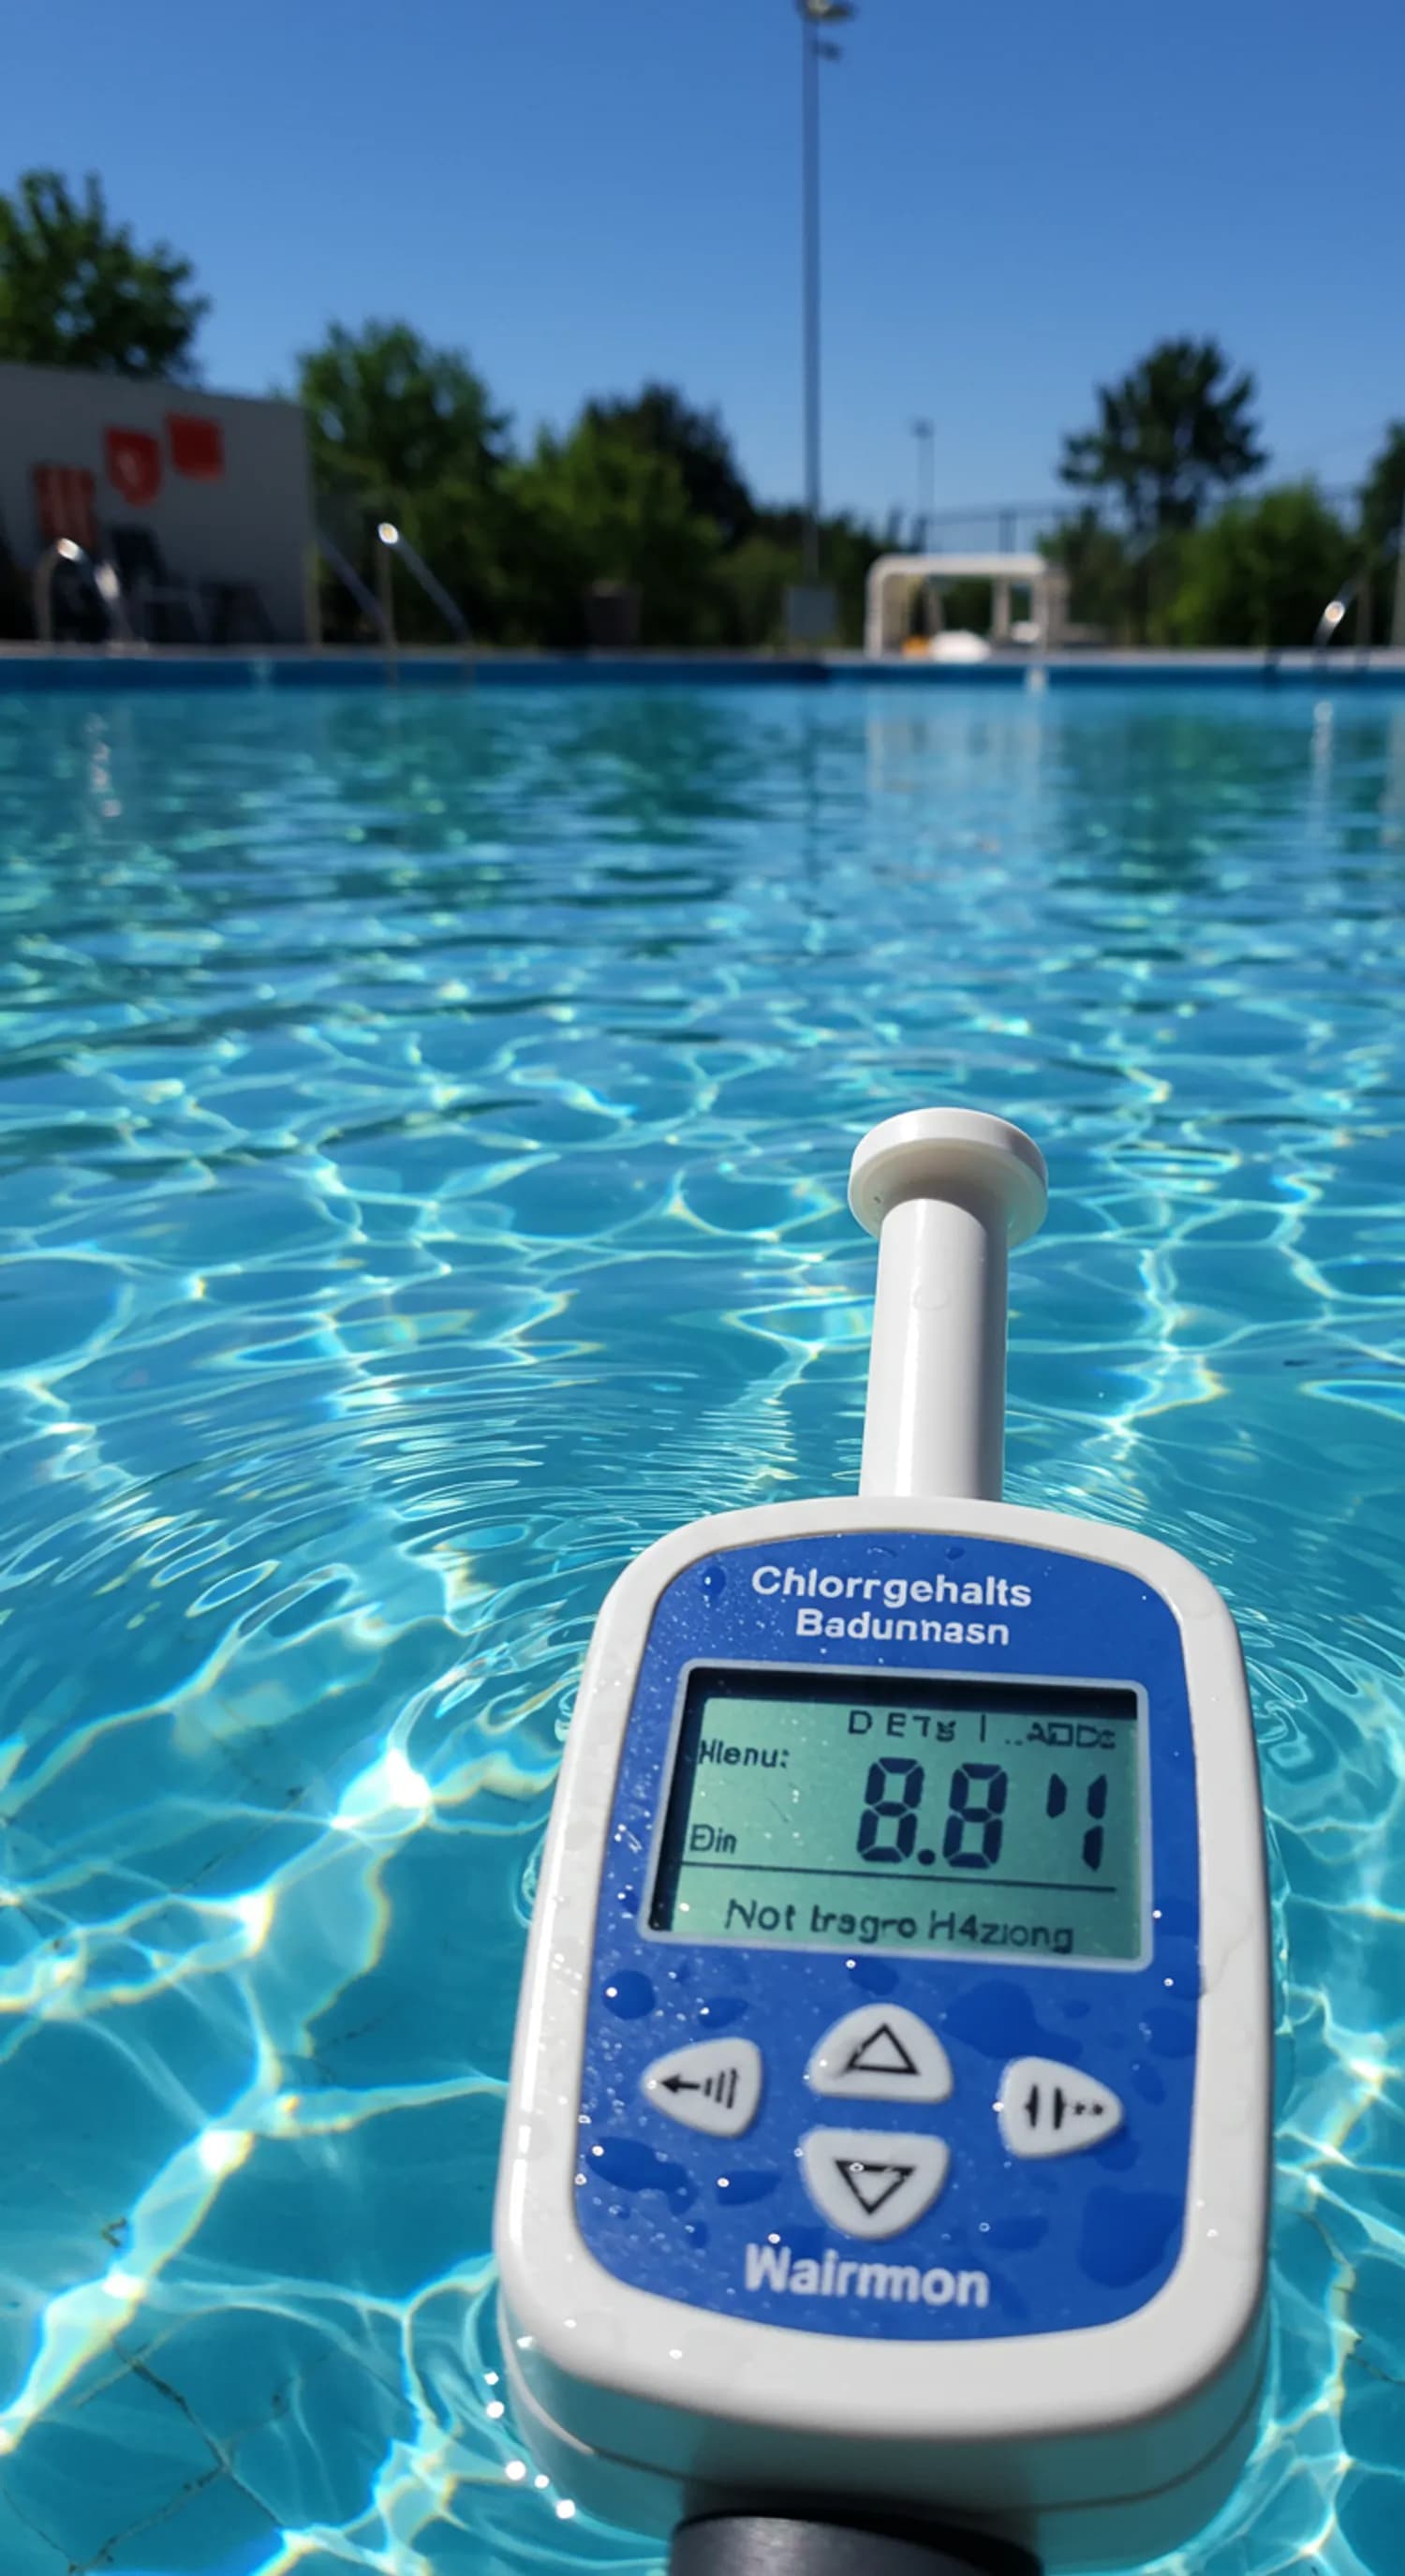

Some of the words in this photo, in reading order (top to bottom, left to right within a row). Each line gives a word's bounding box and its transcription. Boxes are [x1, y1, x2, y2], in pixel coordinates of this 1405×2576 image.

[751, 1565, 1032, 1608] Chlorrgehalts
[795, 1607, 1011, 1646] Badunnasn
[724, 1898, 795, 1932] Not
